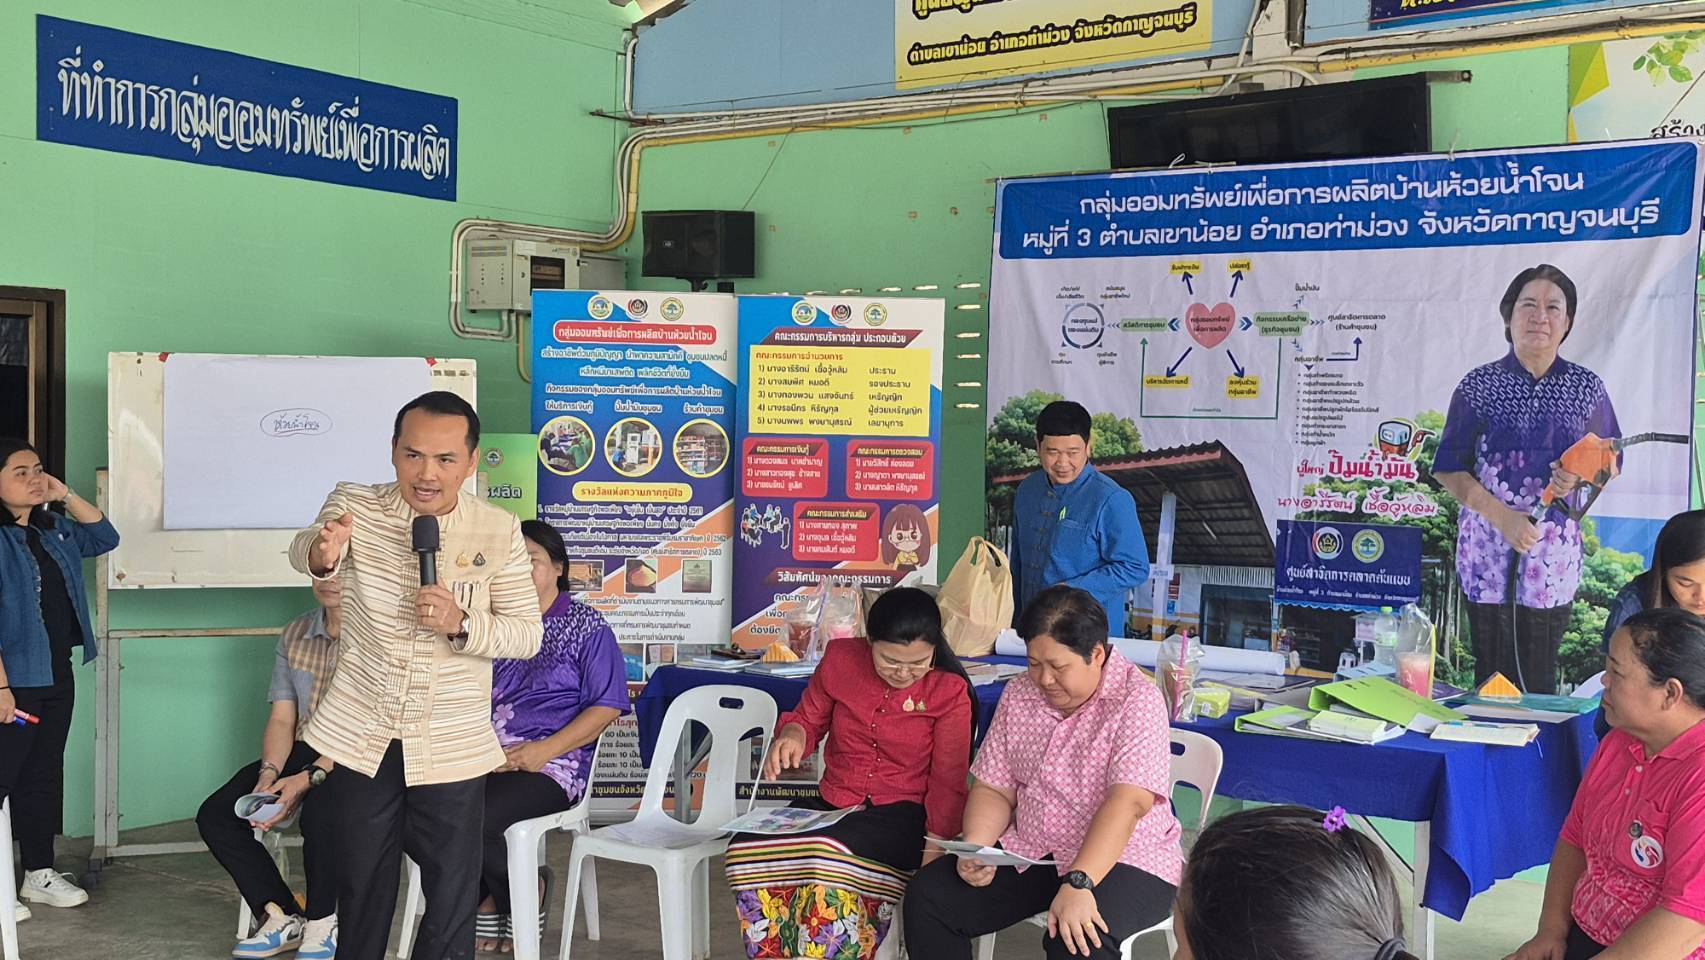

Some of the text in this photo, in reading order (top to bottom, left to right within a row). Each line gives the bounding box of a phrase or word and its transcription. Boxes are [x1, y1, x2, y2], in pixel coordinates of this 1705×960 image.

[909, 6, 1195, 63] ตำบลเขาน้อย อำเภอท่าม่วง จังหวัดกาญจนบุรี
[57, 46, 450, 179] ที่ทำการกลุ่มออมทรัพย์เพื่อการผลิต
[1080, 162, 1584, 219] กลุ่มออมทรัพย์เพื่อการผลิตบ้านห้วยน้ำโจน
[1023, 198, 1661, 255] หมู่ที่ 3 ตำบลเขาน้อย อำเภอท่าม่วง จังหวัดกาญจนบุรี
[558, 324, 713, 340] กลุ่มออมทรัพย์เพื่อการผลิตบ้านห้วยน้ำโจน
[774, 330, 906, 345] คณะกรรมการบริหารกลุ่ม ประกอบด้วย
[869, 367, 896, 375] ประธาน
[869, 380, 911, 388] รองประธาน
[757, 391, 765, 399] 3)
[757, 404, 765, 412] 4)
[757, 417, 764, 425] 5)
[1328, 449, 1416, 480] ปั๊มน้ำมัน
[1286, 564, 1411, 586] ศูนย์สาธิตการตลาดต้นแบบ
